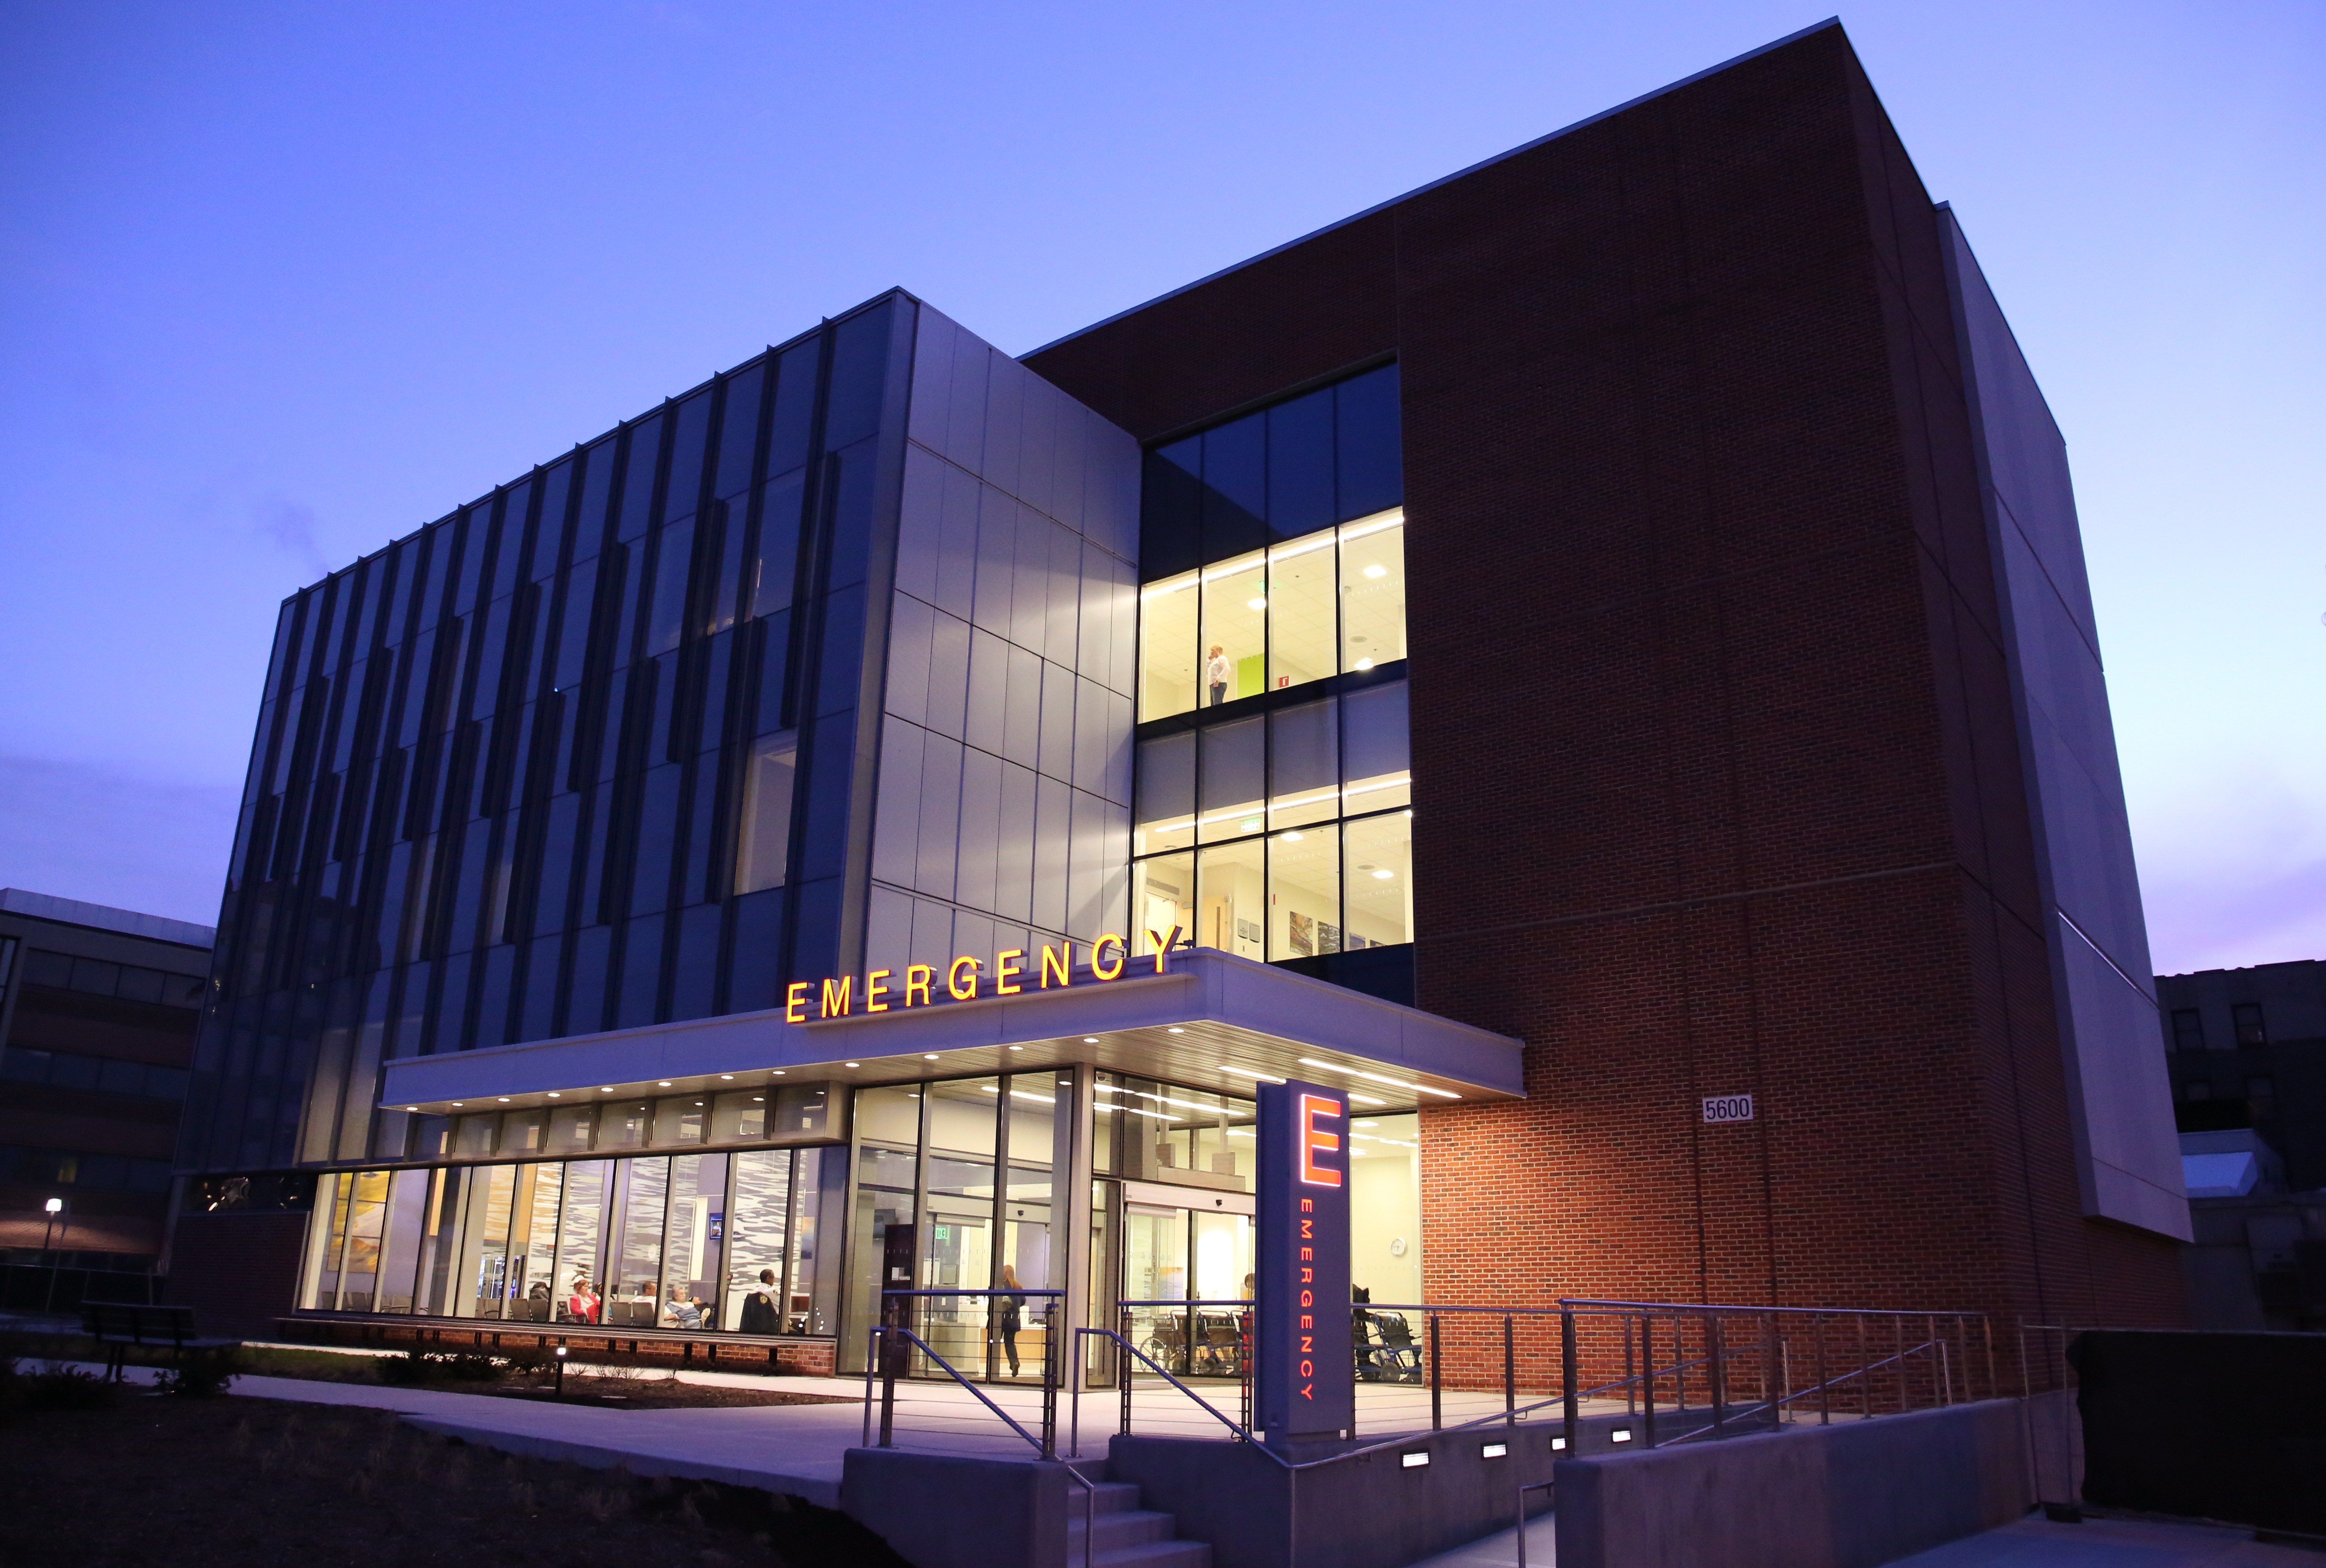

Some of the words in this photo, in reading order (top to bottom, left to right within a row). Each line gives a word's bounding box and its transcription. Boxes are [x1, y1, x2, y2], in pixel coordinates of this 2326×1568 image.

[786, 924, 1181, 1024] EMERGENCY
[1301, 1093, 1341, 1187] E
[1705, 1098, 1749, 1120] 5600
[1300, 1198, 1313, 1400] EMERGENCY
